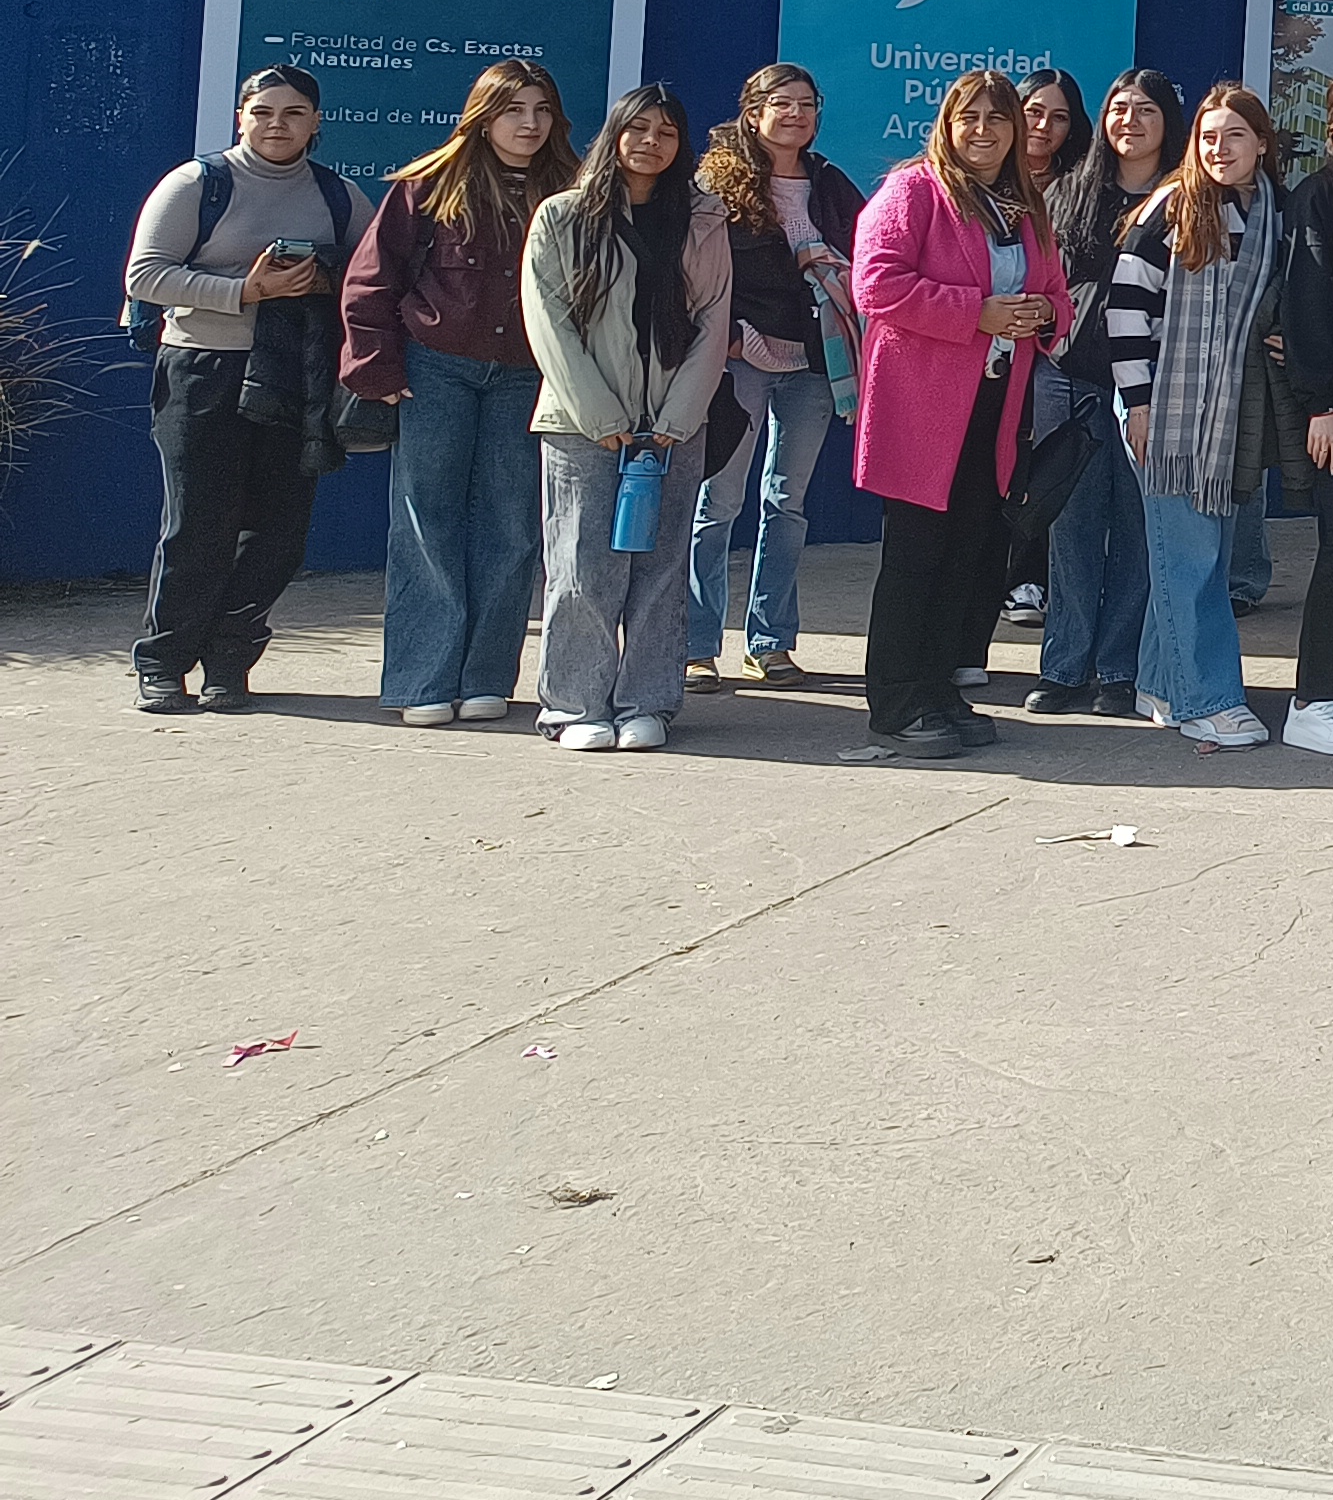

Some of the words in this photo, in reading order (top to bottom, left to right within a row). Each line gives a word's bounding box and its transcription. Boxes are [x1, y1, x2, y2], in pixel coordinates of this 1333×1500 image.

[1292, 2, 1311, 12] del
[1313, 2, 1330, 13] 10
[291, 32, 384, 51] Facultad
[392, 36, 418, 51] de
[426, 38, 457, 53] Cs.
[464, 40, 544, 57] Exactas
[288, 52, 301, 68] y
[310, 51, 413, 69] Naturales
[870, 42, 1051, 74] Universidad
[318, 106, 379, 123] cultad
[386, 109, 413, 124] de
